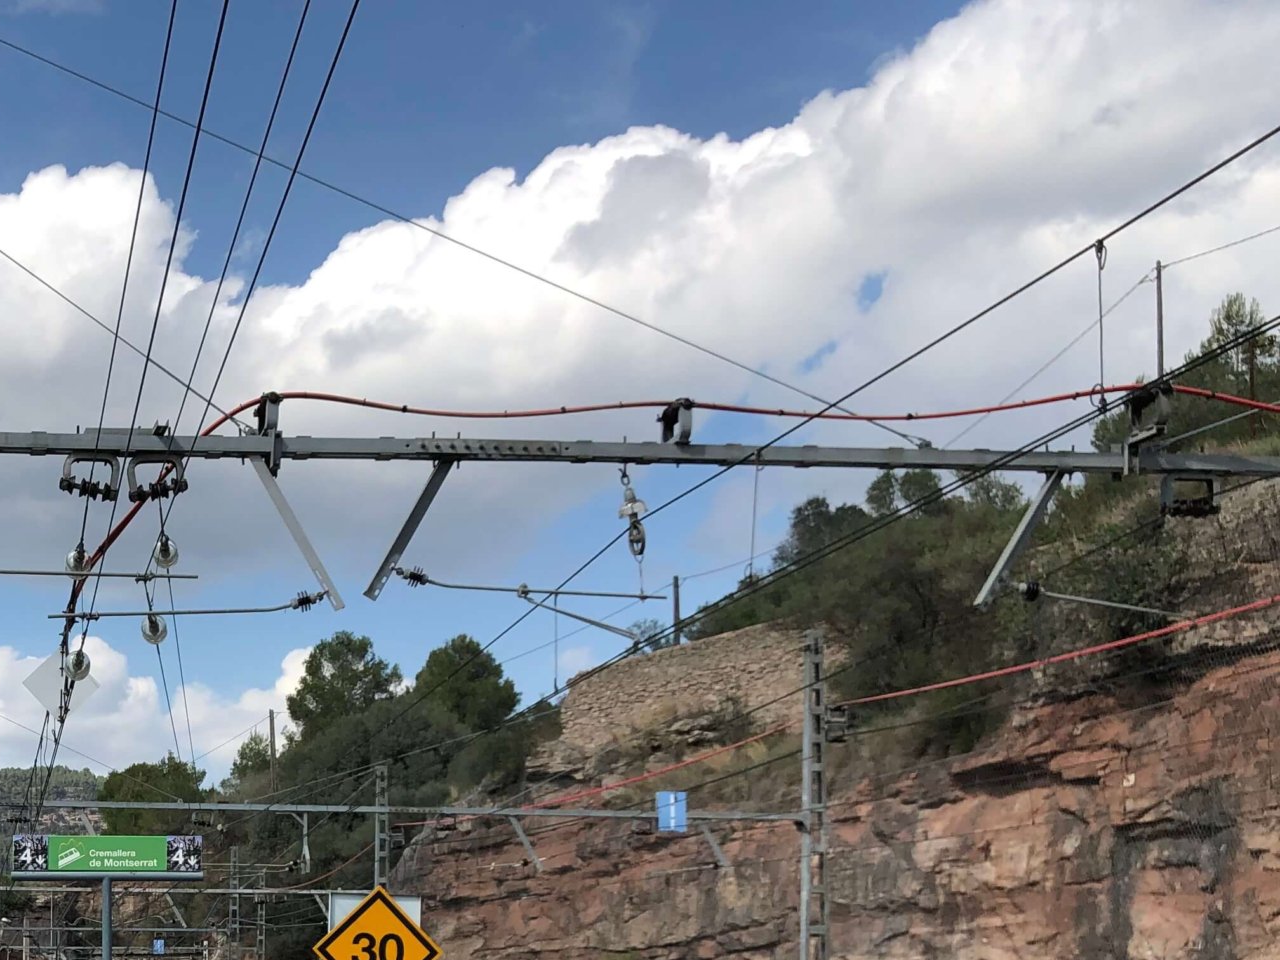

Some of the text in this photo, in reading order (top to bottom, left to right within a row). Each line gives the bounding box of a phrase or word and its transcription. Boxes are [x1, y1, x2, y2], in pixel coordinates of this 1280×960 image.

[20, 847, 32, 864] 4
[89, 849, 136, 857] Cremallera
[172, 848, 185, 864] 4
[89, 859, 158, 867] de Montserrat
